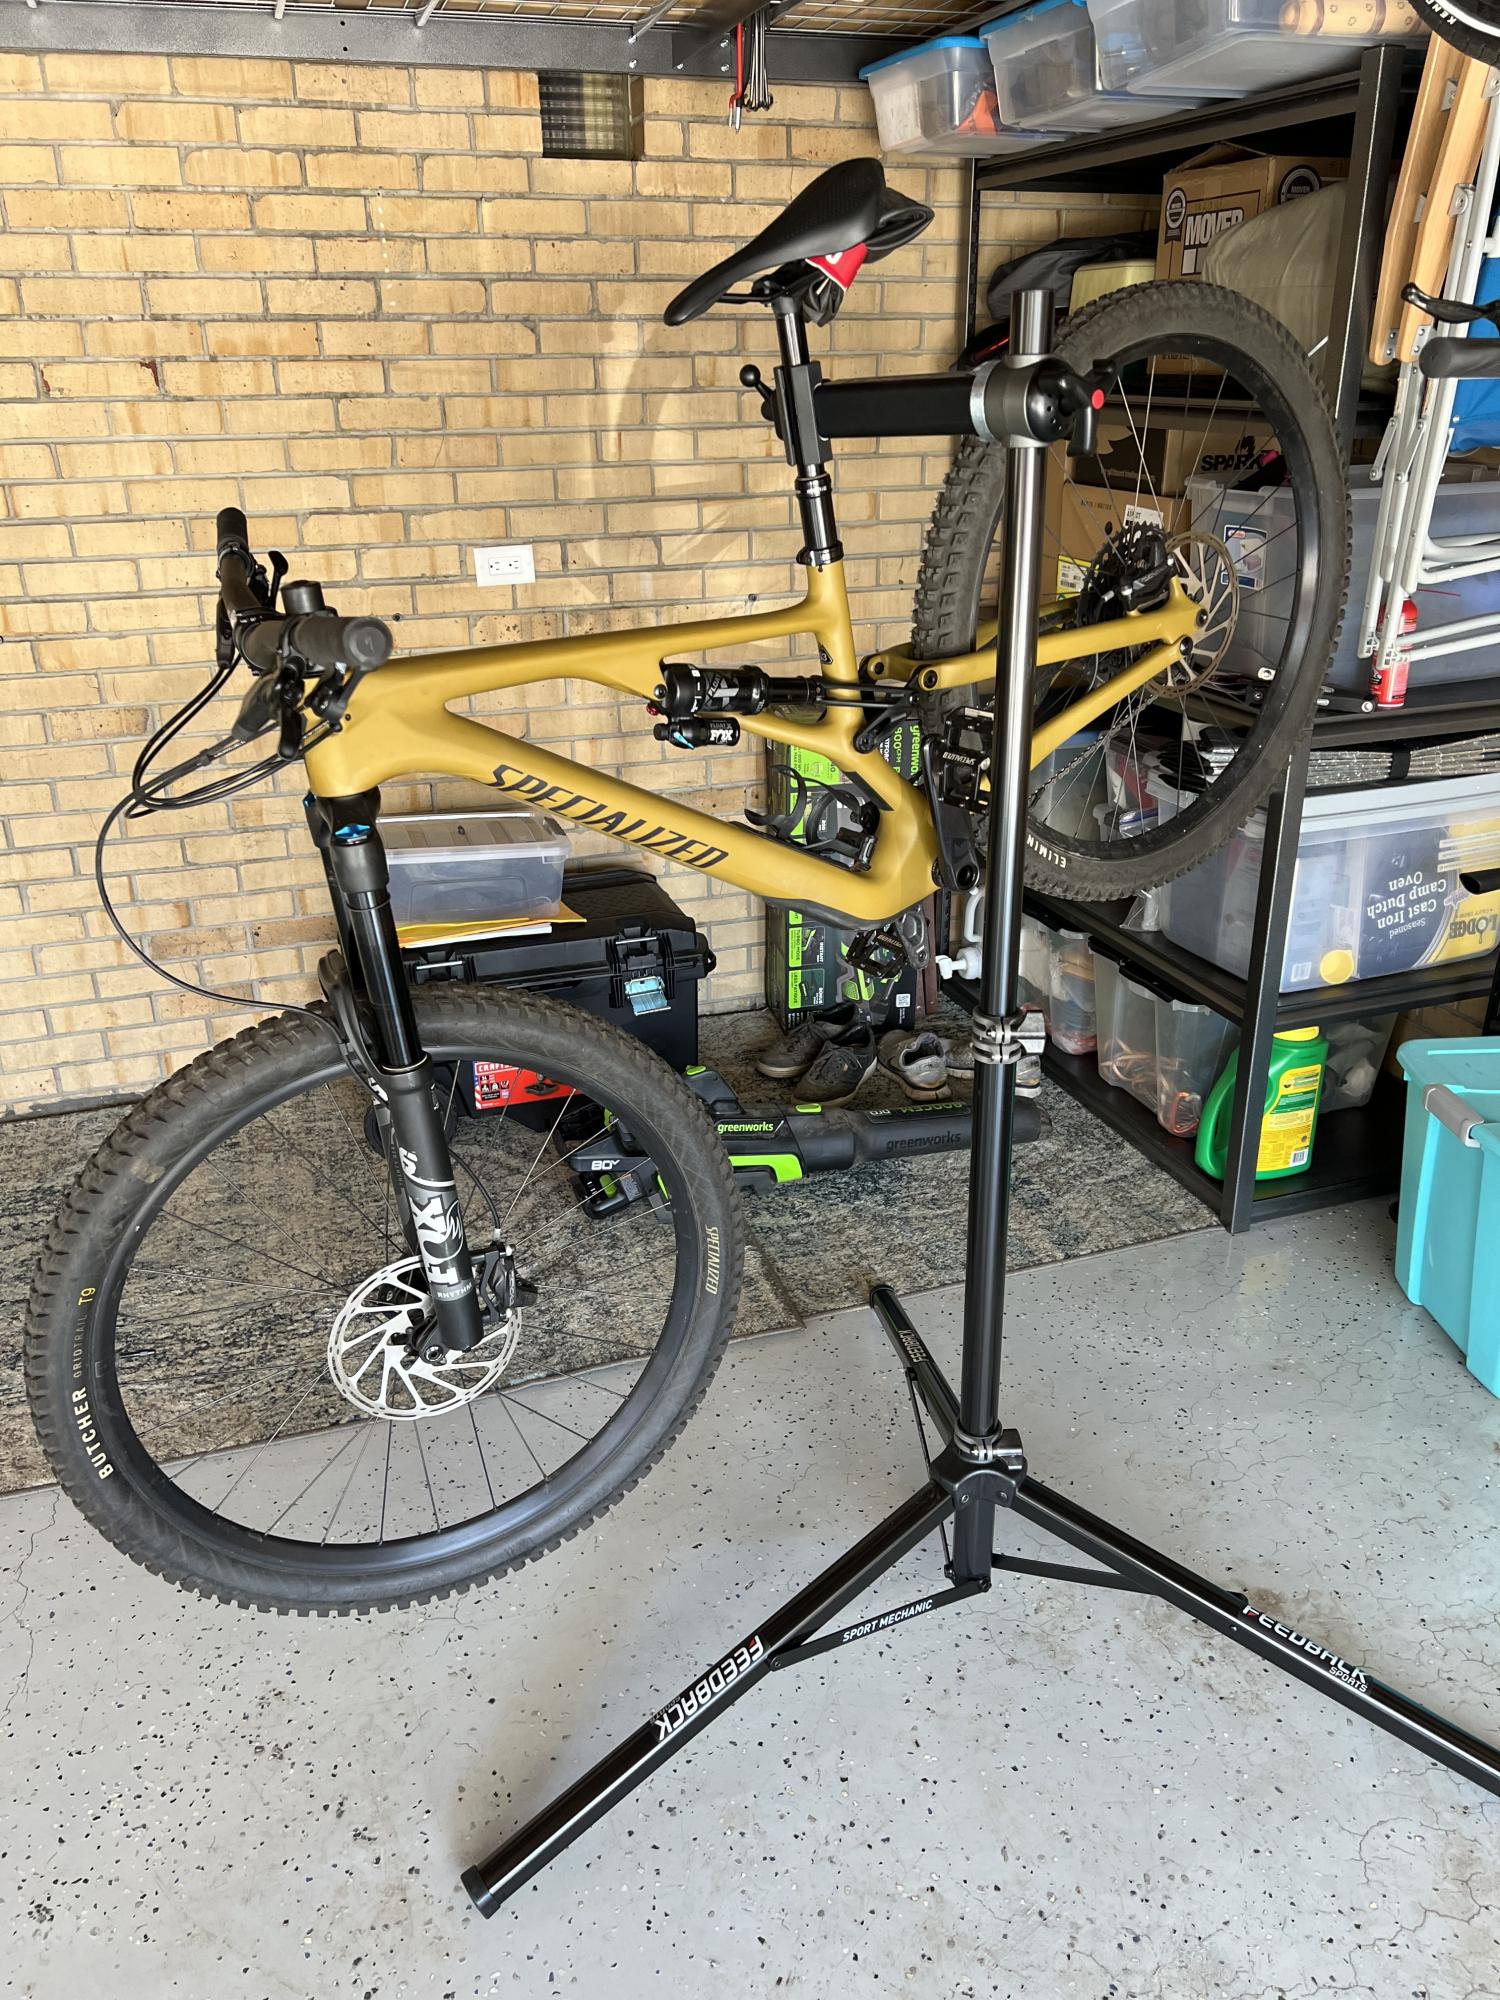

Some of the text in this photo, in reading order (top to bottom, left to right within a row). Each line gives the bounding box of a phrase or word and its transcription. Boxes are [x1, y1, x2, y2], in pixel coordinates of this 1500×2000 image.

[710, 729, 734, 744] FOX
[489, 764, 729, 869] SPECIALIZED
[1389, 871, 1423, 891] Oven
[1367, 879, 1447, 919] Camp Dutch
[1377, 898, 1437, 929] Cast Iron
[1389, 917, 1427, 939] Seasoned
[1449, 914, 1498, 944] LODGE
[717, 1121, 774, 1135] greenworks
[886, 1130, 962, 1151] greenworks
[409, 1194, 463, 1287] FOX
[704, 1223, 721, 1296] SPECIALIZED
[78, 1286, 96, 1306] T9
[437, 1282, 473, 1299] RHYTHM
[72, 1386, 114, 1480] BUTCHER
[842, 1599, 934, 1643] SPORT MECHANIC
[1243, 1604, 1369, 1685] FEEDBACK
[655, 1636, 763, 1742] FEEDBACK
[1329, 1666, 1370, 1694] SPORTS
